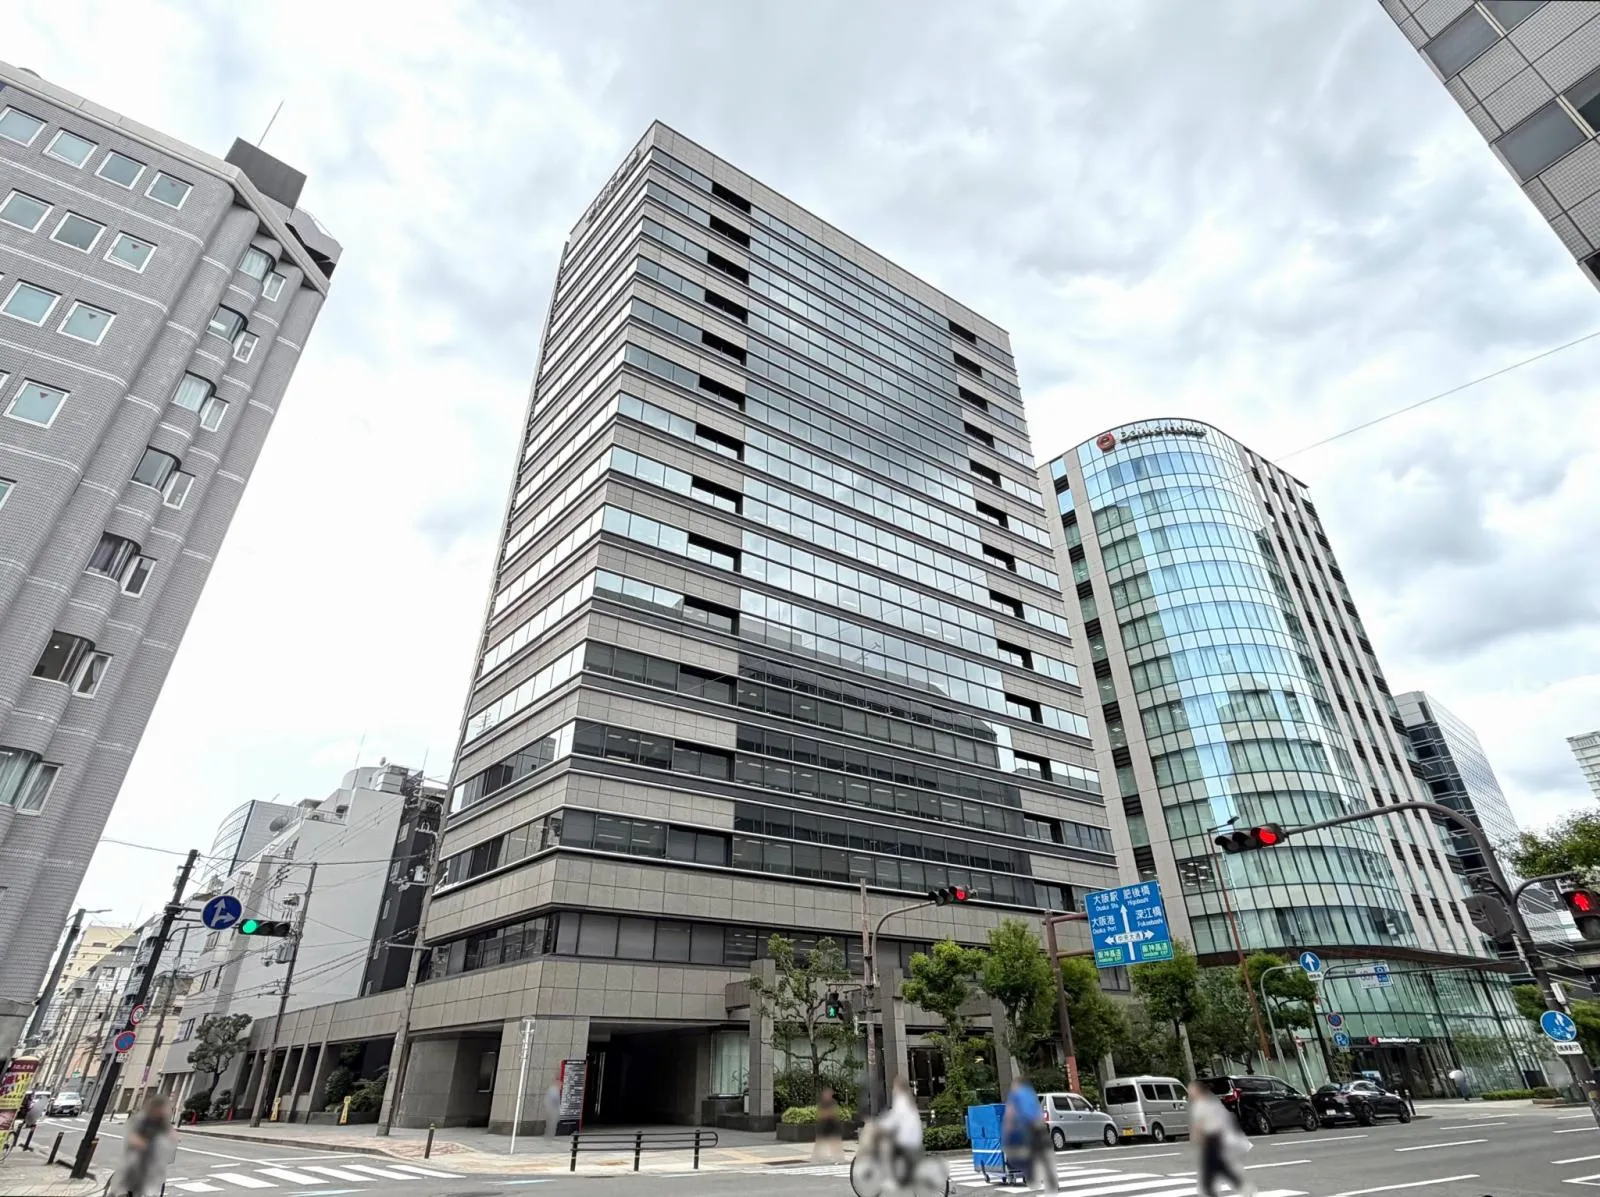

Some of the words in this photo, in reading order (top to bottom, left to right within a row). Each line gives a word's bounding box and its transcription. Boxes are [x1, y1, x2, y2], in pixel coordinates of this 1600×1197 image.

[1094, 891, 1120, 904] 大阪駅
[1135, 906, 1162, 919] 深江橋
[1091, 915, 1116, 927] 大阪港
